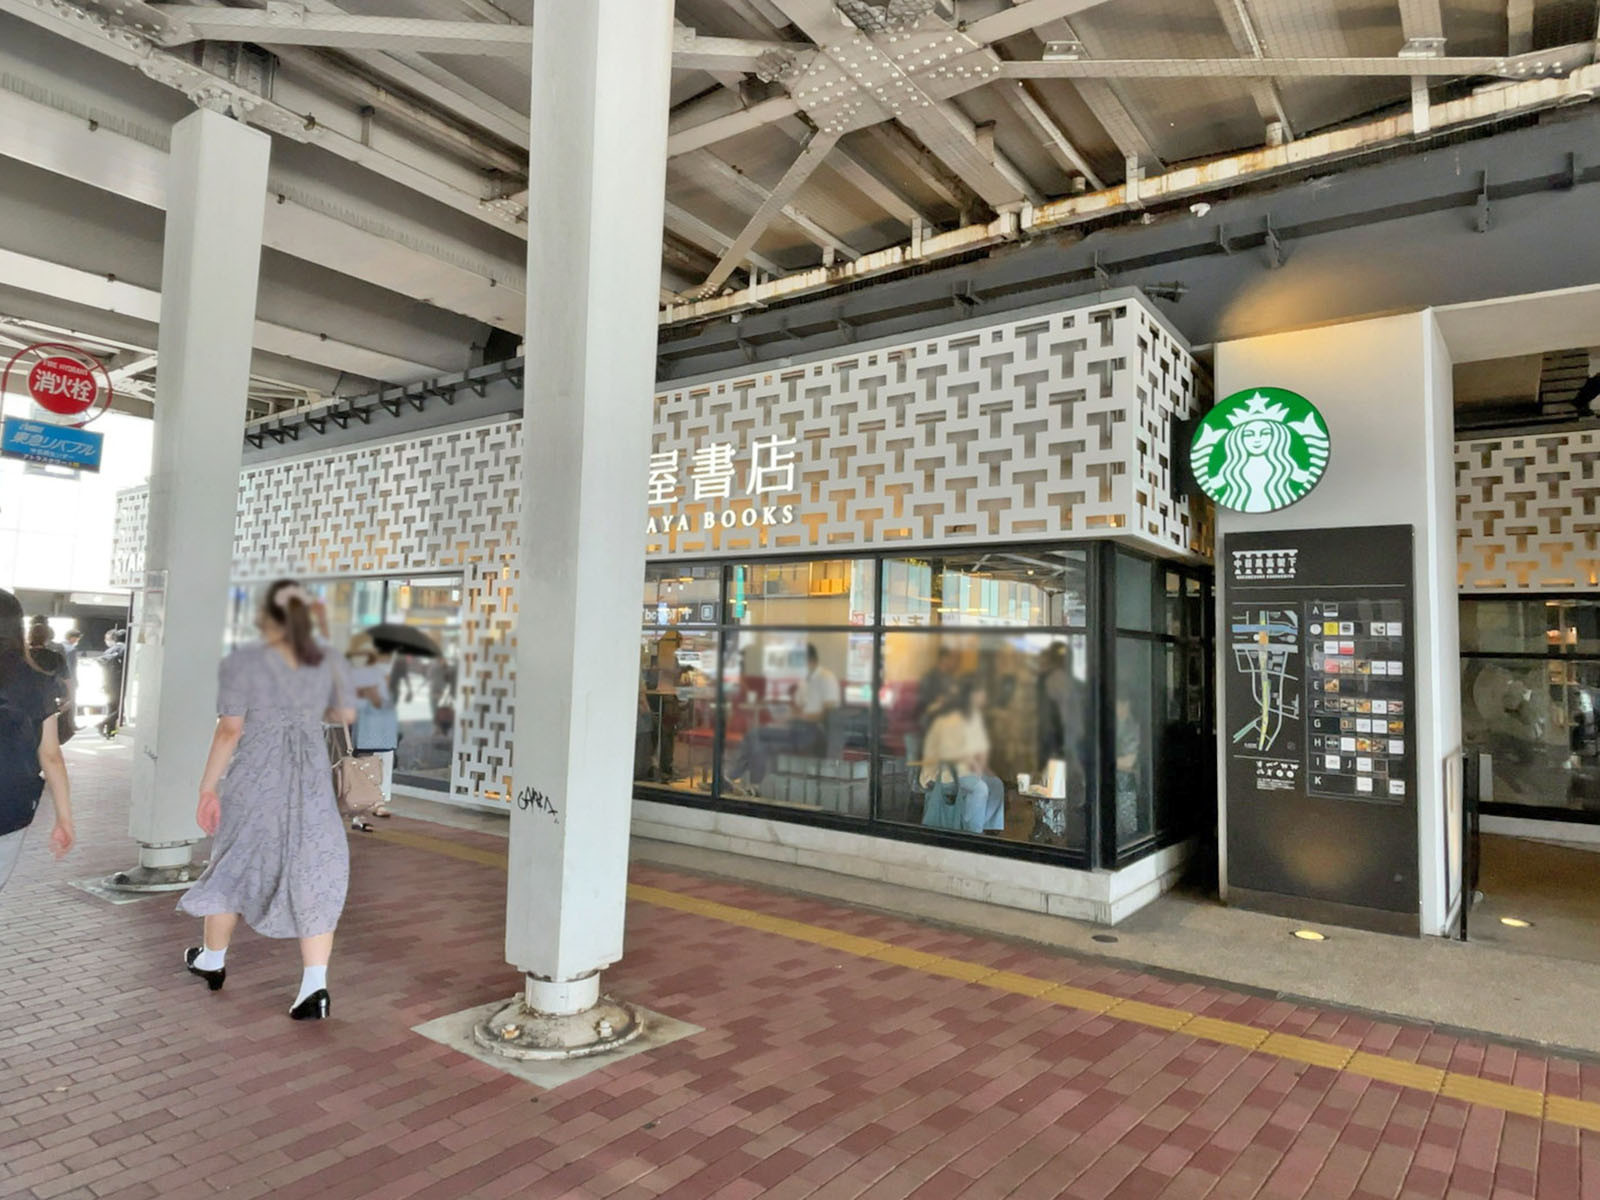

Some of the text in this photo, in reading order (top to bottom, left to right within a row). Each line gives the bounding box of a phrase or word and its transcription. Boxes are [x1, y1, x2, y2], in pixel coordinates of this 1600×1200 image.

[33, 368, 93, 402] 消火栓
[648, 435, 798, 505] 屋書店
[646, 504, 794, 535] AYA BOOKS
[1312, 605, 1320, 615] A
[1313, 680, 1320, 690] E
[1314, 700, 1320, 708] F
[1314, 719, 1321, 728] G
[1314, 738, 1321, 747] H
[1346, 759, 1352, 768] J
[1314, 776, 1322, 785] K
